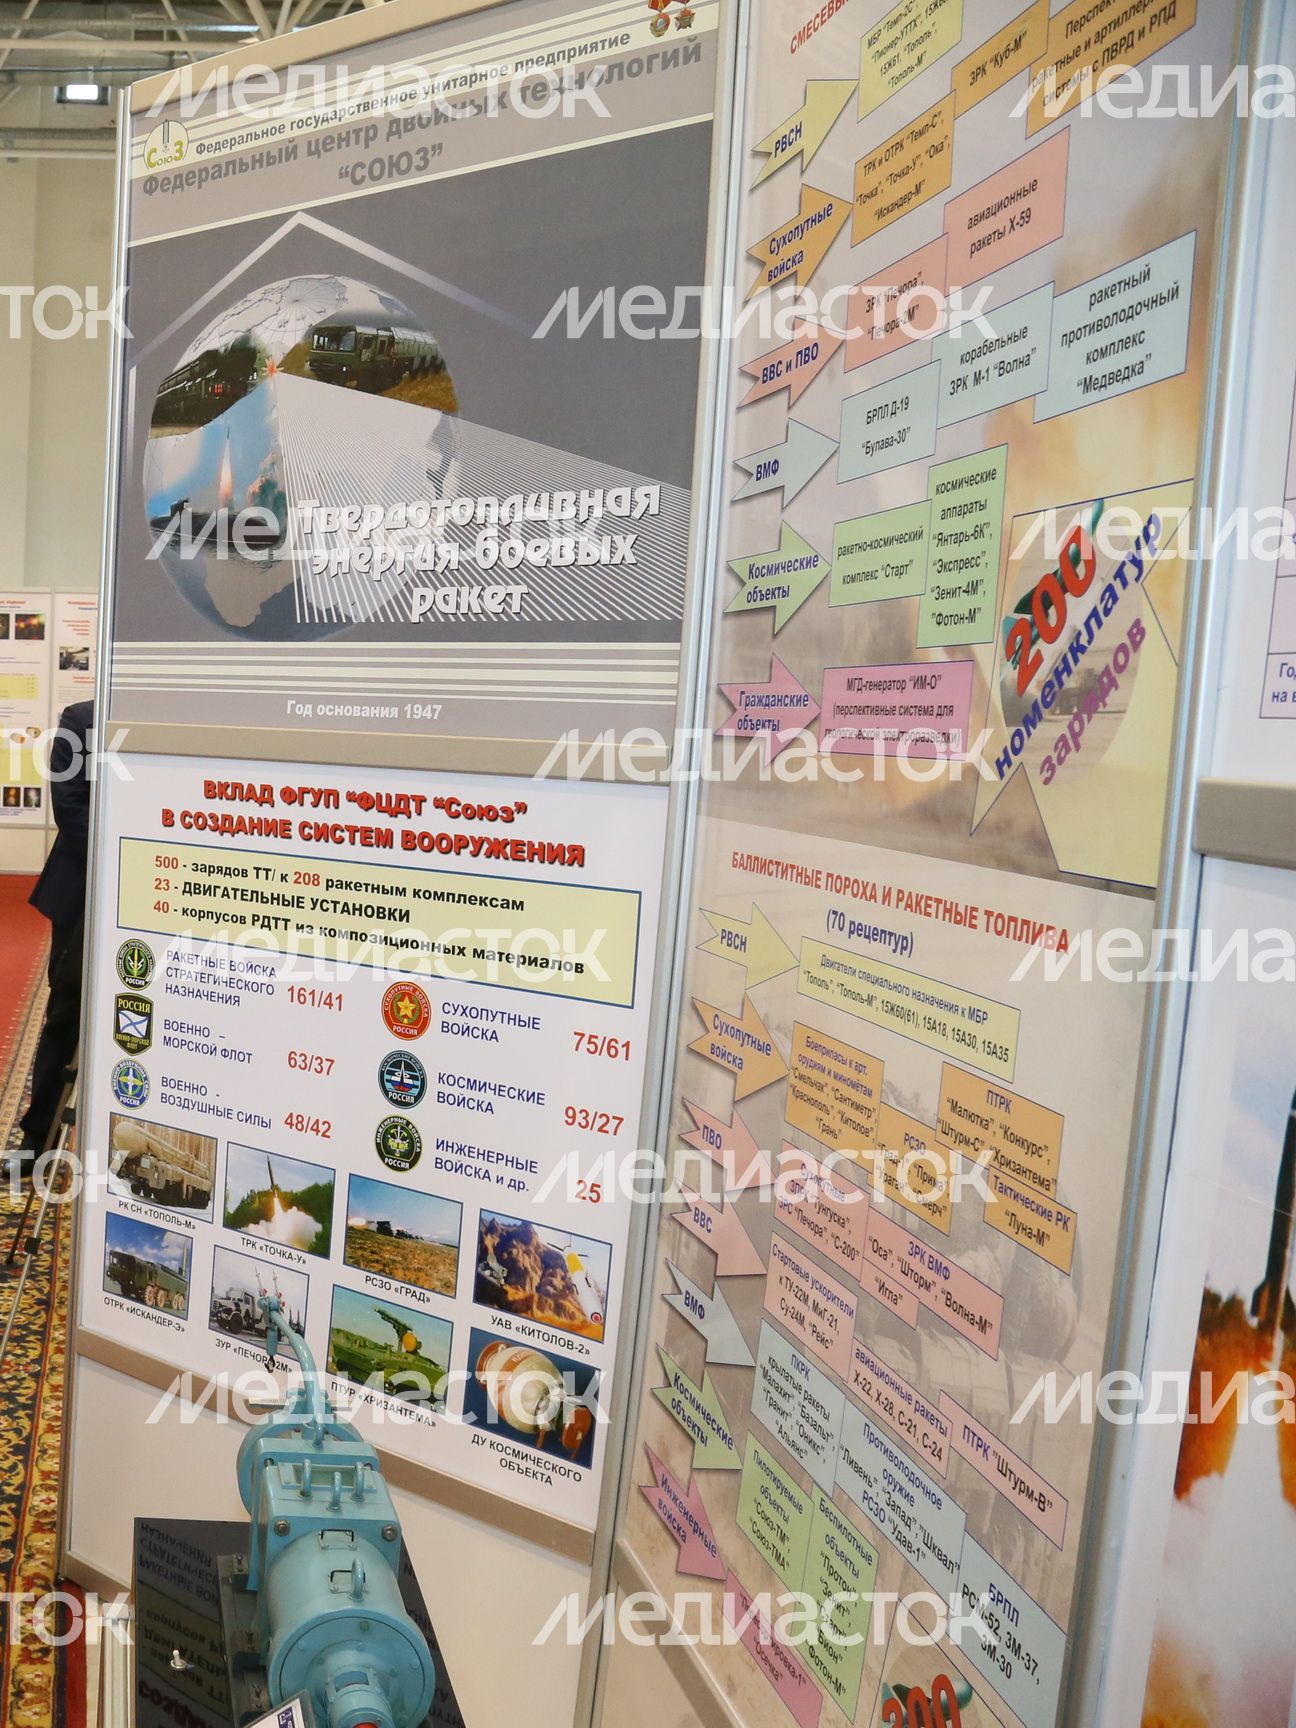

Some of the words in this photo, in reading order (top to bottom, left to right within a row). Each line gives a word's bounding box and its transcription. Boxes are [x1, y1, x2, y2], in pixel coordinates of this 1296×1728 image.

[196, 124, 285, 155] Федеральное
[290, 89, 417, 132] государственное
[422, 65, 508, 100] унитарное
[515, 32, 630, 73] предприятие
[143, 137, 298, 195] Федеральный
[307, 124, 378, 159] центр
[386, 90, 506, 141] двойных
[520, 36, 701, 104] технологий
[774, 121, 802, 158] РВСН
[967, 178, 1038, 230] авиационные
[769, 203, 833, 255] Сухопутные
[970, 226, 1006, 259] ракеты
[768, 250, 804, 282] войска
[1089, 263, 1151, 312] ракетный
[1061, 280, 1180, 347] противолодочный
[761, 359, 783, 384] ВВС
[795, 342, 819, 368] ПВО
[960, 325, 1028, 366] корабельные
[1085, 329, 1146, 365] комплекс
[755, 458, 779, 482] ВМФ
[935, 468, 997, 495] космические
[298, 485, 661, 539] Твердотопливная
[940, 498, 987, 522] аппараты
[313, 541, 460, 580] энергия
[475, 528, 637, 570] боевых
[837, 525, 924, 560] ракетно-космический
[748, 553, 819, 580] Космические
[842, 567, 878, 585] комплекс
[412, 584, 528, 623] ракет
[746, 584, 790, 604] объекты
[1005, 525, 1096, 697] 200
[995, 513, 1161, 780] номенклатур
[739, 690, 809, 710] Гражданские
[846, 676, 907, 693] МГД-генератор
[1040, 618, 1147, 785] зарядов
[287, 700, 311, 718] Год
[316, 704, 398, 719] основания
[404, 703, 442, 720] 1947
[737, 714, 780, 732] объекты
[898, 704, 934, 717] система
[204, 780, 274, 807] ВКЛАД
[280, 785, 339, 808] ФГУП
[162, 808, 175, 828] В
[180, 810, 292, 839] СОЗДАНИЕ
[299, 821, 393, 848] СИСТЕМ
[401, 829, 584, 867] ВООРУЖЕНИЯ
[154, 878, 170, 891] 23
[182, 882, 305, 909] ДВИГАТЕЛЬНЫЕ
[311, 897, 410, 923] УСТАНОВКИ
[155, 855, 179, 870] 500
[191, 862, 249, 880] зарядов
[293, 871, 320, 886] 208
[326, 877, 406, 897] ракетным
[413, 888, 525, 911] комплексам
[732, 852, 822, 890] БАЛЛИСТИТНЫЕ
[825, 872, 877, 904] ПОРОХА
[895, 890, 978, 930] РАКЕТНЫЕ
[984, 909, 1070, 954] ТОПЛИВА
[153, 901, 170, 914] 40
[182, 906, 247, 924] корпусов
[252, 914, 291, 931] РДТТ
[320, 925, 466, 957] композиционных
[473, 947, 585, 974] материалов
[720, 928, 747, 953] РВСН
[826, 909, 845, 933] (70
[847, 920, 914, 958] рецептур)
[165, 966, 275, 996] СТРАТЕГИЧЕСКОГО
[166, 950, 226, 970] РАКЕТНЫЕ
[229, 958, 277, 978] ВОЙСКА
[118, 998, 151, 1012] РОССИЯ
[165, 983, 241, 1007] НАЗНАЧЕНИЯ
[287, 985, 344, 1012] 161/41
[820, 954, 857, 977] Двигатели
[858, 969, 910, 997] специального
[912, 988, 959, 1016] назначения
[967, 1004, 988, 1025] МБР
[164, 1020, 210, 1038] ВОЕННО
[442, 1002, 541, 1031] СУХОПУТНЫЕ
[441, 1021, 499, 1042] ВОЙСКА
[573, 1031, 631, 1061] 75/61
[713, 1014, 772, 1057] Сухопутные
[163, 1036, 217, 1056] МОРСКОЙ
[220, 1048, 253, 1064] ФЛОТ
[287, 1051, 335, 1076] 63/37
[710, 1043, 743, 1070] войска
[161, 1077, 208, 1096] ВОЕННО
[438, 1072, 546, 1105] КОСМИЧЕСКИЕ
[985, 1089, 1013, 1114] ПТРК
[160, 1093, 233, 1120] ВОЗДУШНЫЕ
[236, 1111, 272, 1129] СИЛЫ
[284, 1112, 332, 1139] 48/42
[437, 1091, 495, 1114] ВОЙСКА
[564, 1106, 625, 1136] 93/27
[436, 1138, 539, 1174] ИНЖЕНЕРНЫЕ
[702, 1125, 722, 1150] ПВО
[434, 1157, 492, 1182] ВОЙСКА
[508, 1178, 529, 1192] др.
[576, 1179, 602, 1203] 25
[993, 1175, 1052, 1222] Тактические
[144, 1207, 196, 1230] «ТОПОЛЬ-М»
[693, 1206, 712, 1233] ВВС
[241, 1237, 257, 1249] ТРК
[259, 1244, 307, 1265] «ТОЧКА-У»
[927, 1253, 951, 1281] ВМФ
[365, 1275, 391, 1292] РСЗО
[394, 1284, 431, 1304] «ГРАД»
[684, 1291, 705, 1320] ВМФ
[104, 1297, 124, 1311] ОТРК
[125, 1304, 185, 1333] «ИСКАНДЕР-Э»
[491, 1315, 512, 1331] УАВ
[515, 1323, 590, 1357] «КИТОЛОВ-2»
[855, 1347, 912, 1405] авиационные
[914, 1398, 948, 1438] ракеты
[671, 1397, 709, 1448] объекты
[673, 1372, 734, 1451] Космические
[471, 1434, 487, 1447] ДУ
[489, 1437, 582, 1483] КОСМИЧЕСКОГО
[962, 1424, 990, 1461] ПТРК
[500, 1459, 553, 1486] ОБЪЕКТА
[863, 1421, 943, 1511] Противолодочное
[862, 1490, 886, 1524] РСЗО
[881, 1469, 916, 1508] оружие
[657, 1498, 688, 1544] войска
[660, 1473, 717, 1558] Инженерные
[988, 1582, 1020, 1627] БРПЛ
